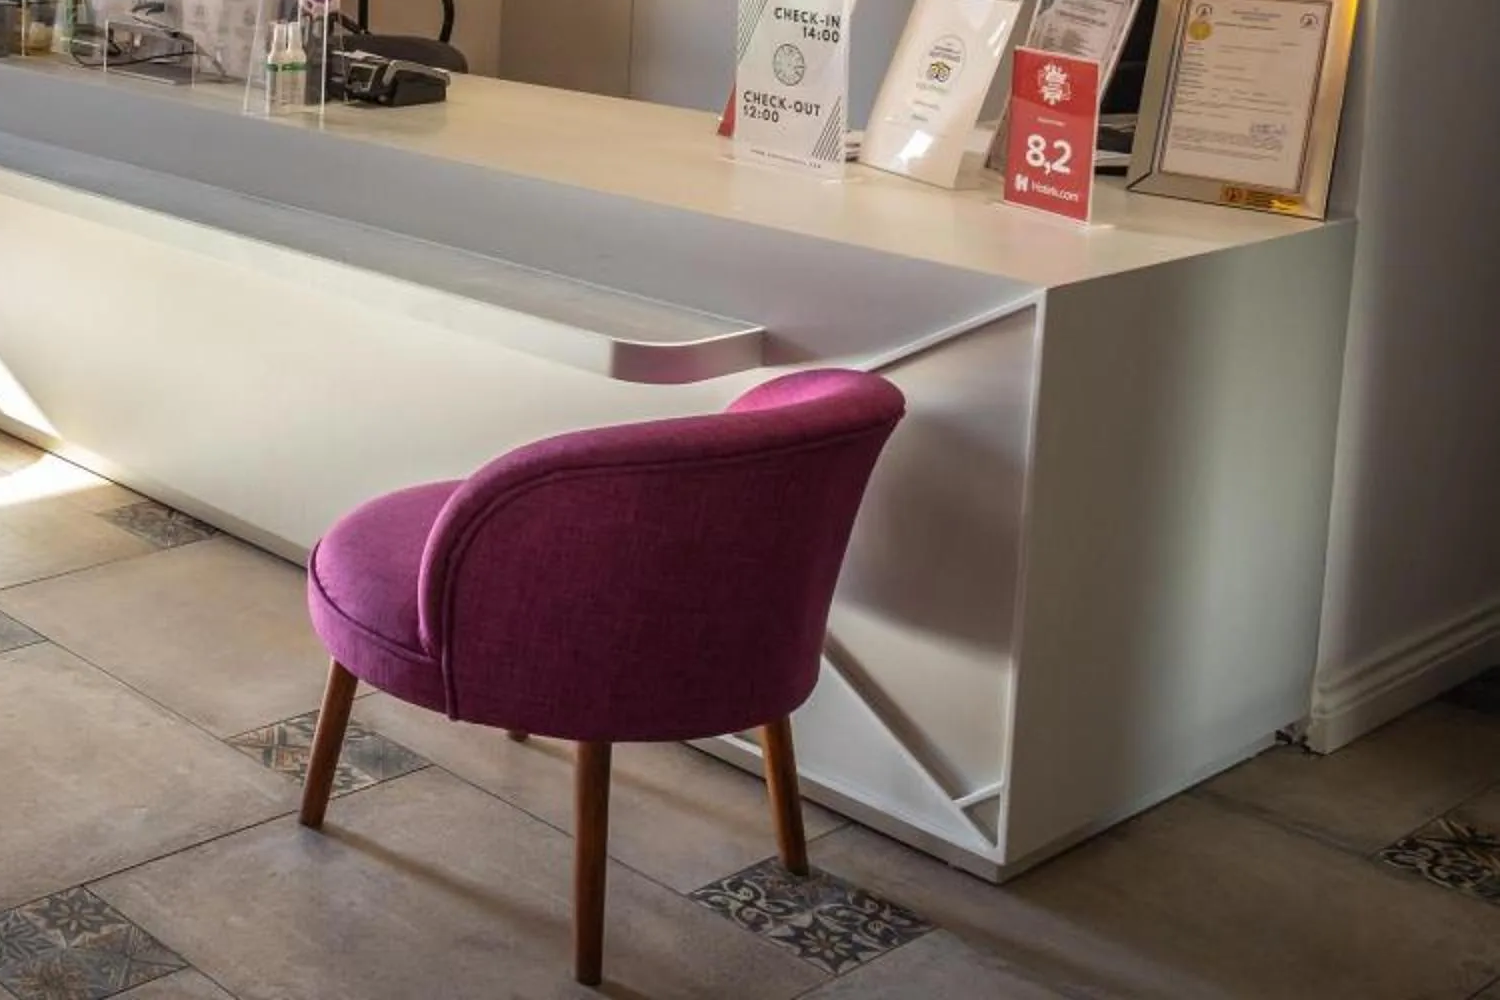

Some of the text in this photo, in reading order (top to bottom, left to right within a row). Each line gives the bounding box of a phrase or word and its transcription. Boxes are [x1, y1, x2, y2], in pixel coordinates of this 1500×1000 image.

[774, 7, 841, 29] CHECK-IN
[802, 26, 840, 43] 14:00
[743, 90, 821, 117] CHECK-OUT
[743, 105, 779, 123] 12:00
[1025, 133, 1072, 175] 8,2
